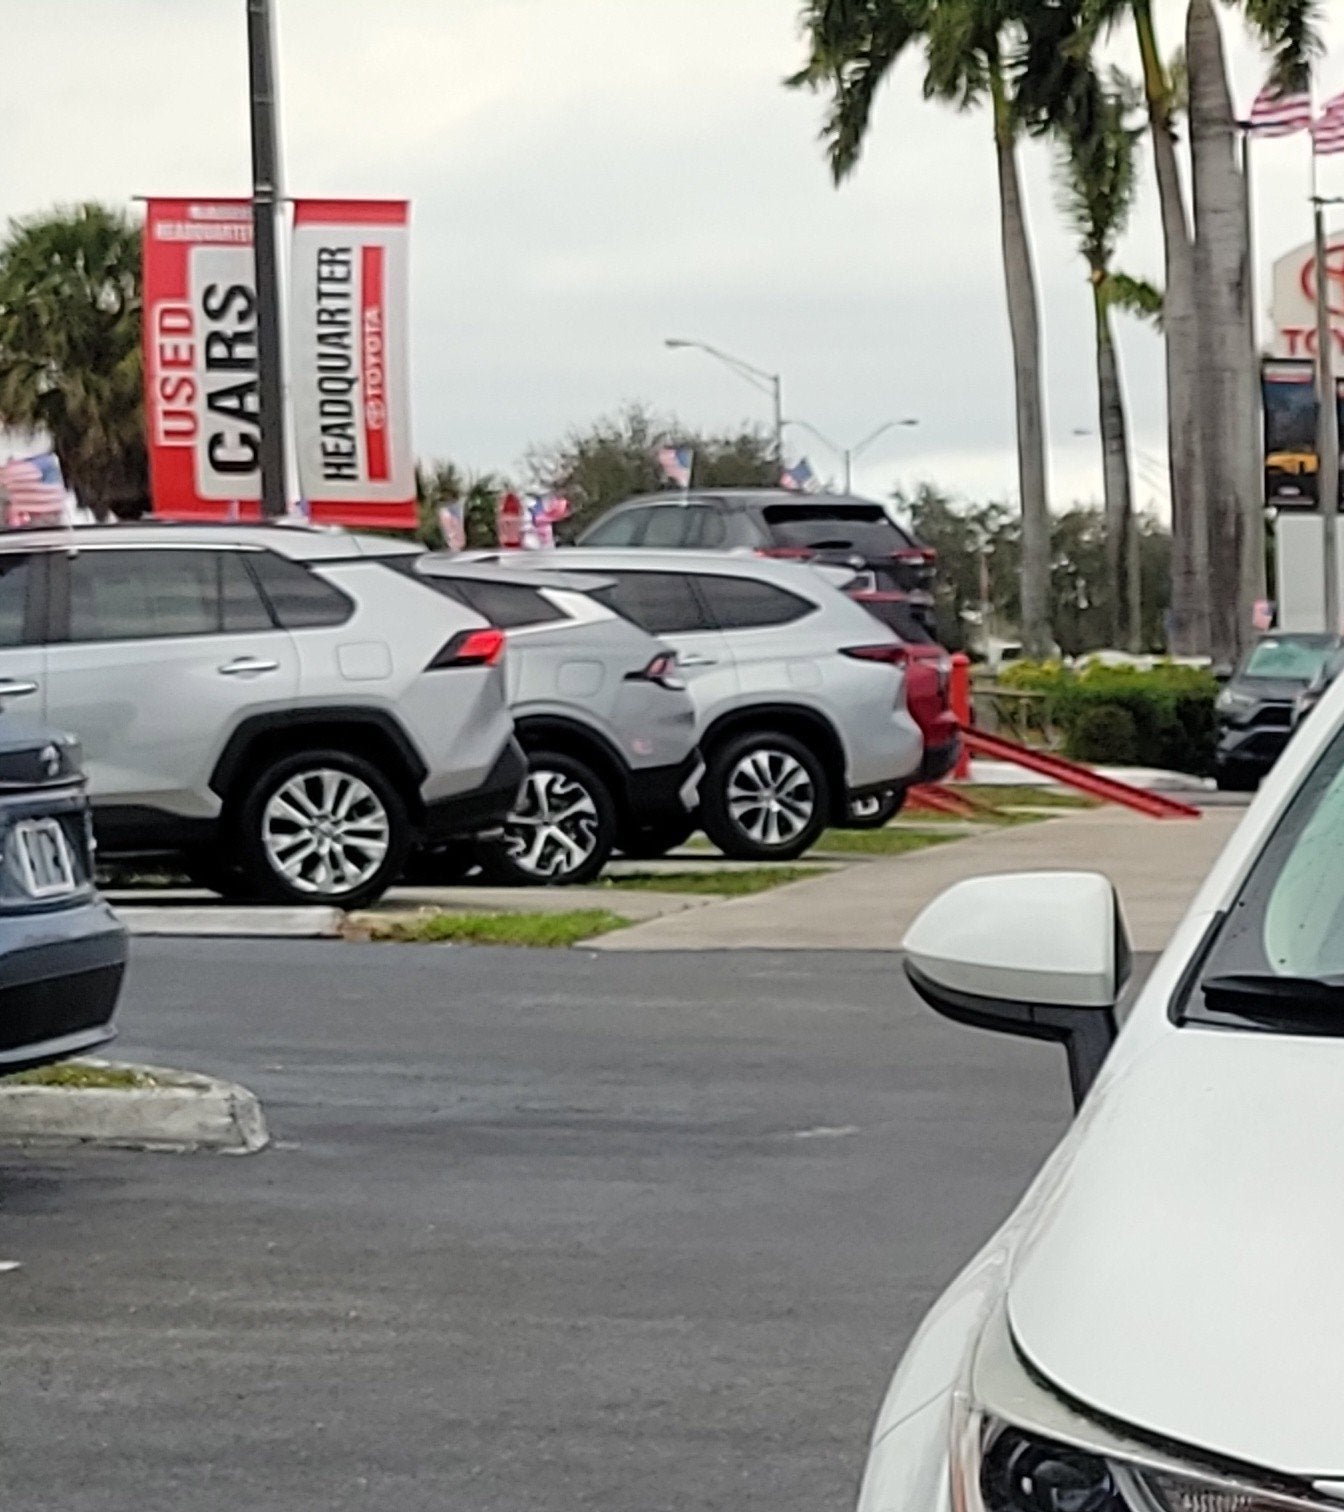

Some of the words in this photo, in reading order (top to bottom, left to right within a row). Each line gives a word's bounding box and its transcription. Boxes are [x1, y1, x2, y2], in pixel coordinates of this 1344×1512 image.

[159, 307, 198, 440] USED
[202, 283, 262, 474] CARS
[316, 246, 358, 481] HEADQUARTER
[364, 308, 385, 396] TOYOTA
